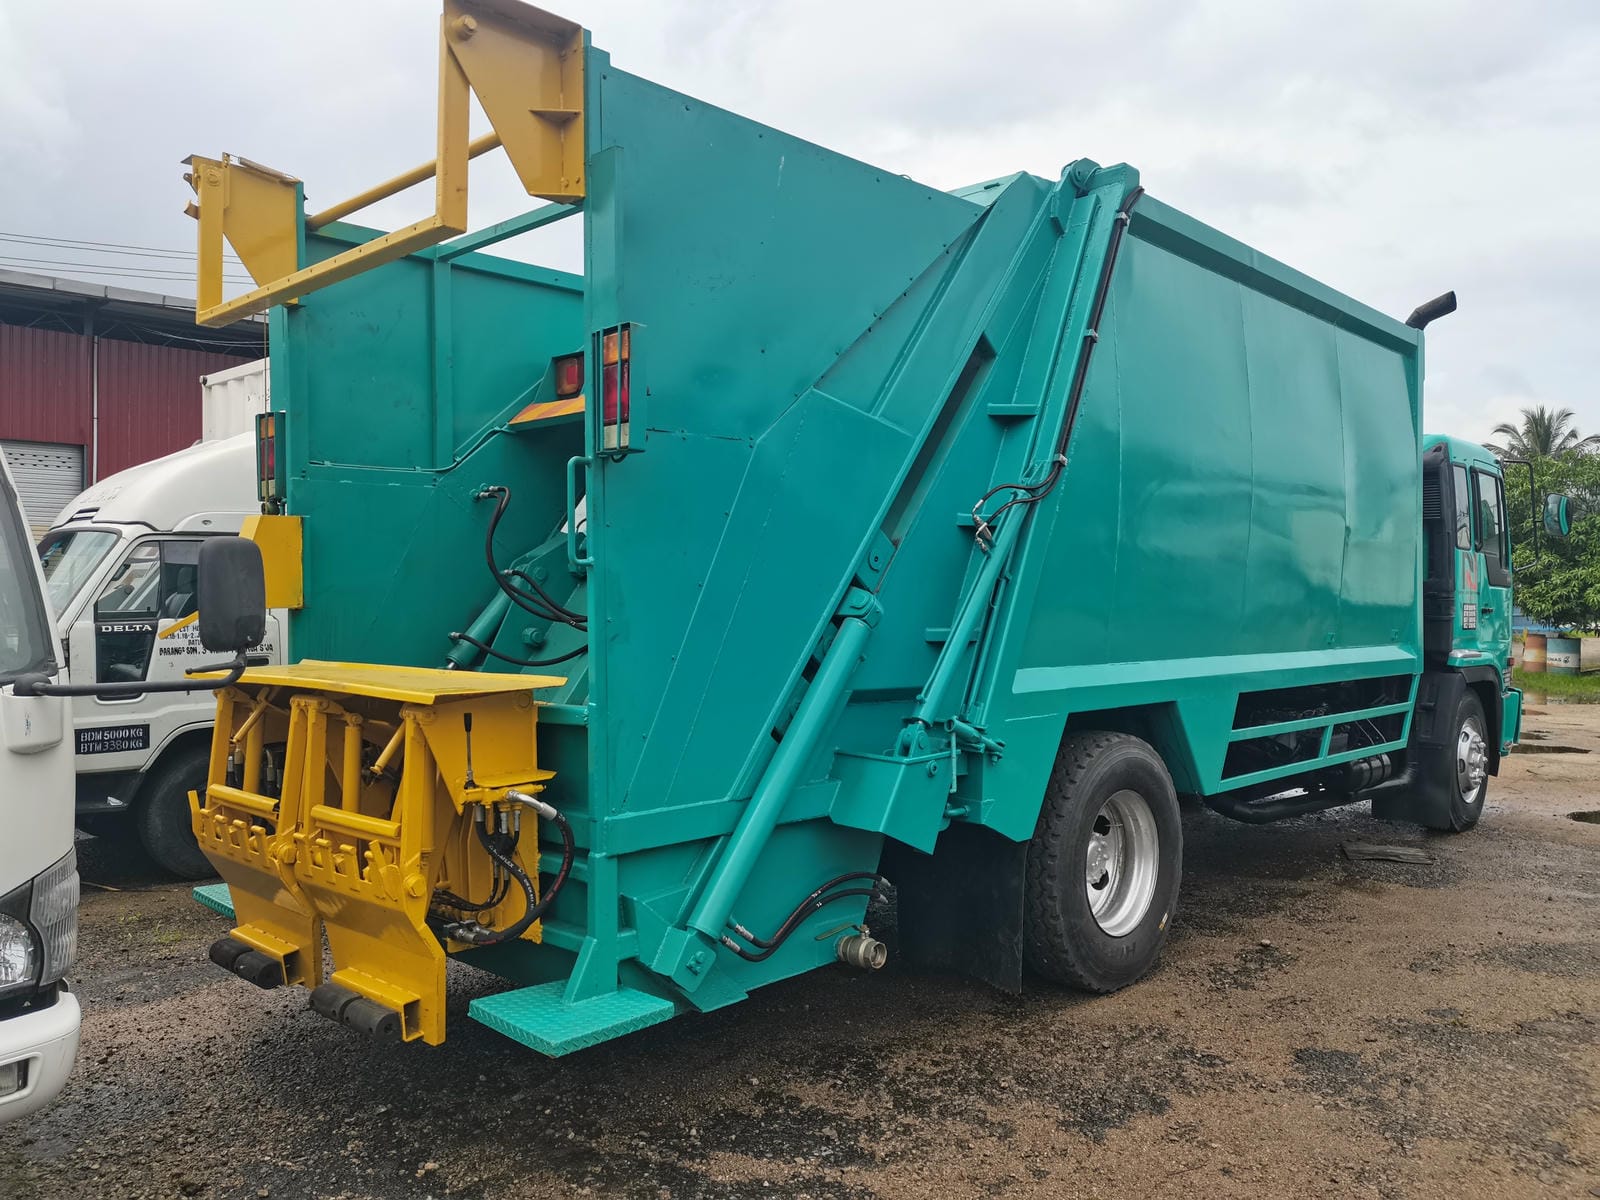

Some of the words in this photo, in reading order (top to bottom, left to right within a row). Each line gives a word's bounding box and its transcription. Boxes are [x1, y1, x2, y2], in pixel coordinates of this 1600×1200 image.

[101, 624, 153, 633] DELTA
[80, 730, 102, 742] BDM
[103, 729, 129, 741] 5000
[130, 728, 143, 738] KG
[80, 742, 102, 753] BTM
[103, 740, 129, 751] 3380
[130, 739, 143, 749] KG
